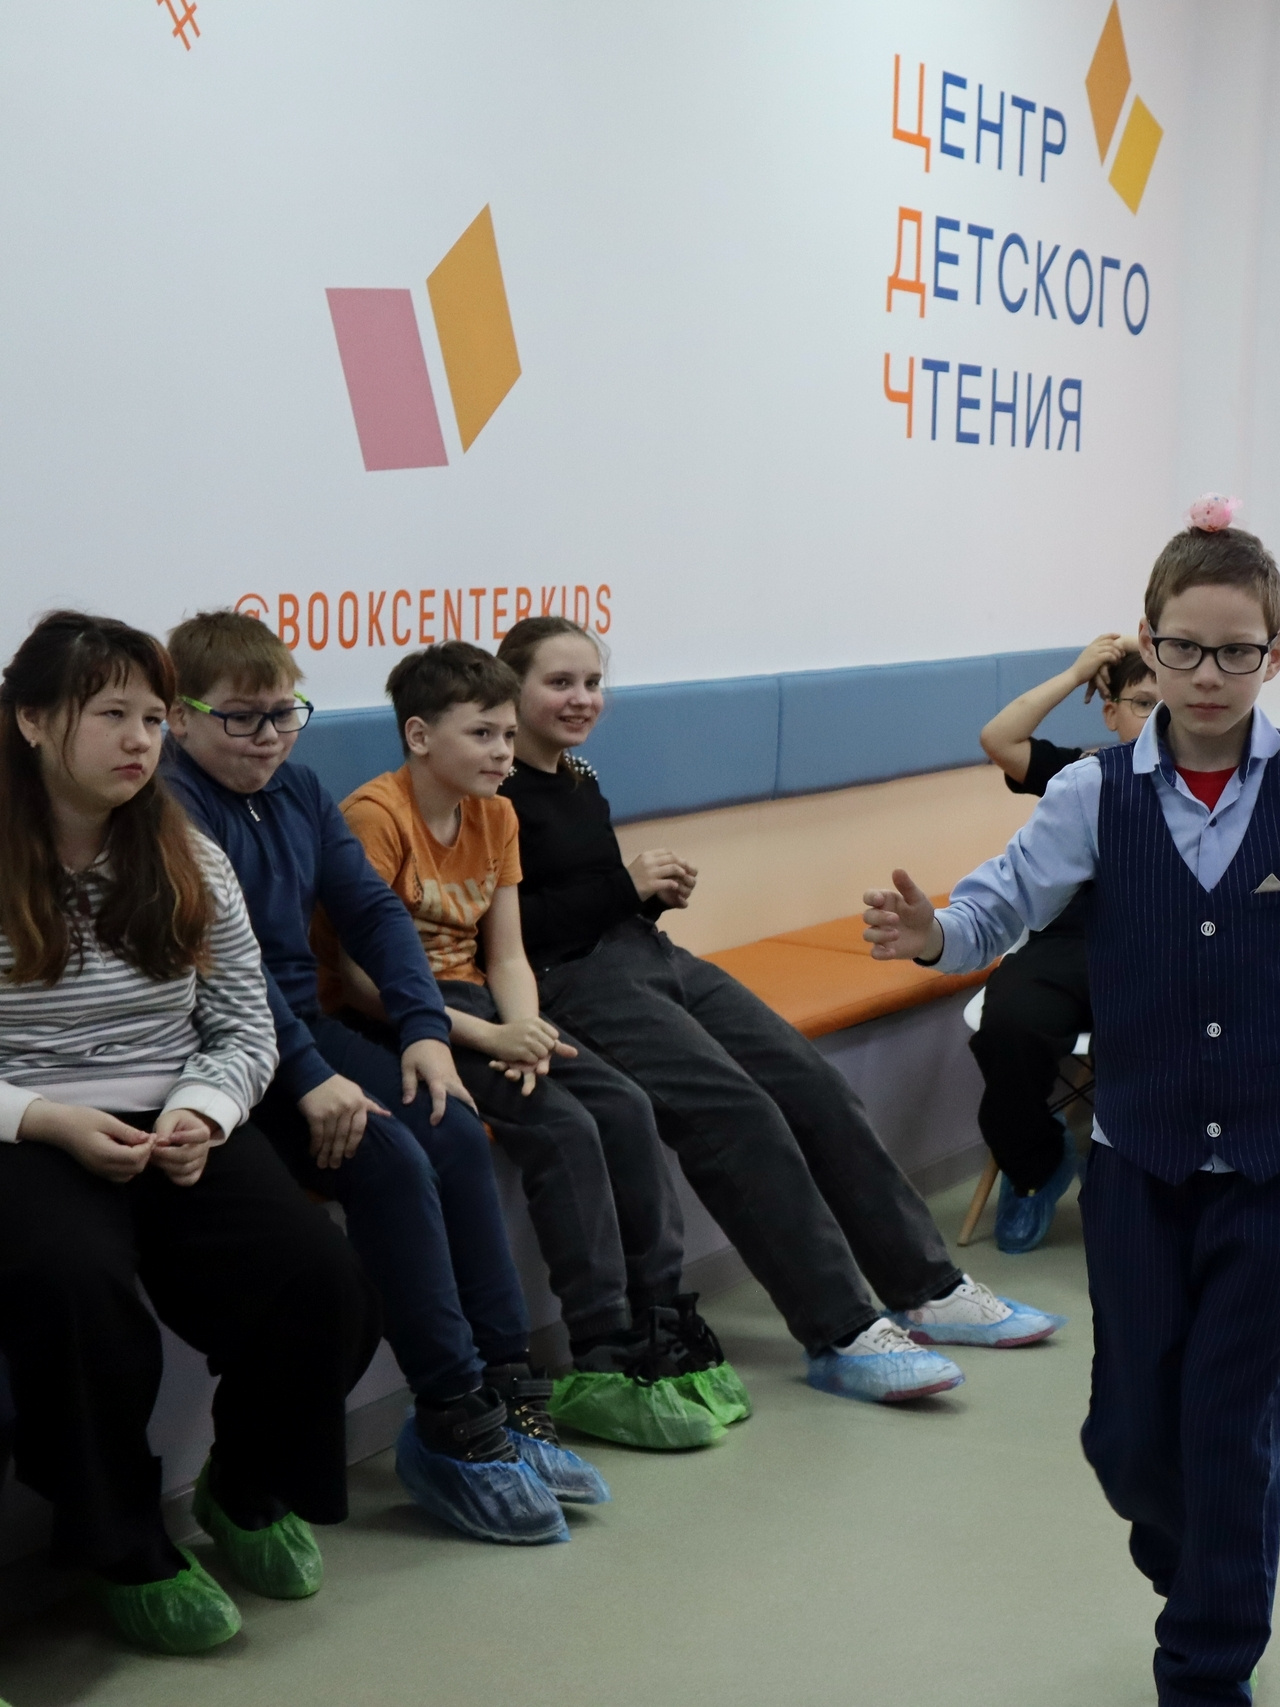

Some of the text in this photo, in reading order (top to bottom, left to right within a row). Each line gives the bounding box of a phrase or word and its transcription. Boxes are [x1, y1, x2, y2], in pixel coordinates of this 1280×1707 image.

[892, 53, 1067, 183] ЦЕНТР
[886, 206, 1149, 335] ДЕТСКОГО
[884, 353, 1082, 452] ЧТЕНИЯ
